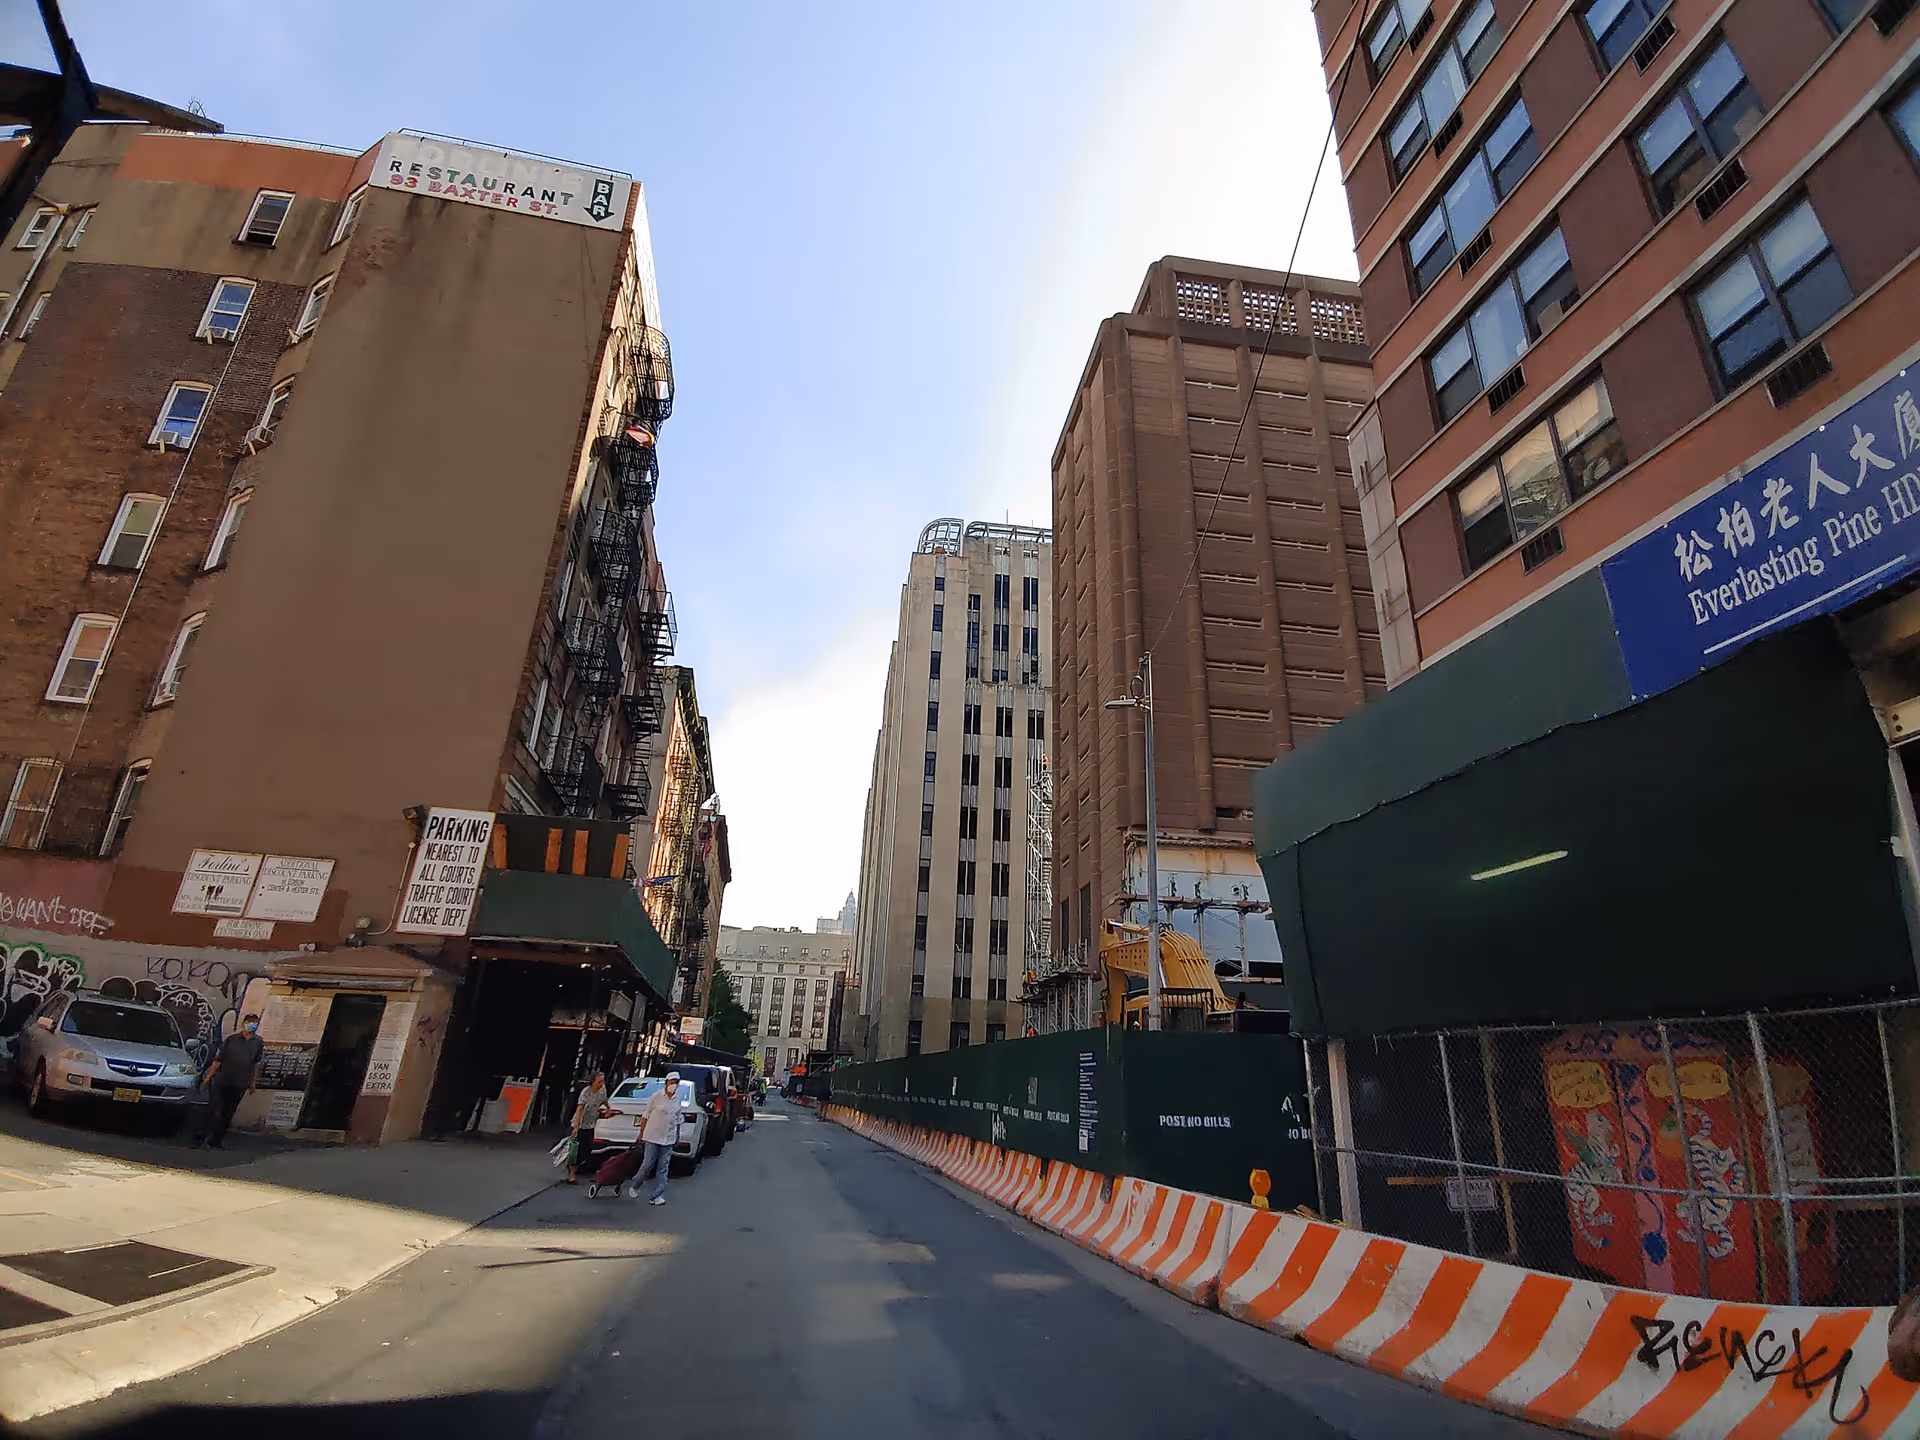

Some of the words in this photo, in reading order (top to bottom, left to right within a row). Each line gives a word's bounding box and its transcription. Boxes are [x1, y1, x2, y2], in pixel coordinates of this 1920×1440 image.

[389, 160, 574, 206] RESTAURANT
[389, 173, 418, 189] 93
[427, 180, 519, 209] BAXTER
[529, 200, 560, 216] ST.
[591, 183, 610, 217] BAR
[1687, 536, 1825, 626] Everlasting
[1823, 503, 1882, 557] Pine
[1880, 465, 1920, 525] HD
[426, 816, 490, 843] PARKING
[424, 842, 465, 861] NEAREST
[467, 846, 480, 864] TO
[186, 872, 221, 883] DISCOUNT
[222, 875, 252, 885] PARKING
[263, 868, 297, 878] DISCOUNT
[297, 871, 329, 881] PARKING
[418, 863, 435, 881] ALL
[408, 883, 444, 904] TRAFFIC
[445, 886, 475, 906] COURT
[402, 905, 441, 925] LICENSE
[441, 908, 467, 928] DEPT.
[373, 1062, 390, 1071] VAN
[365, 1081, 392, 1090] EXTRA
[1159, 1115, 1185, 1127] POST
[1186, 1116, 1202, 1127] NO
[1203, 1116, 1231, 1128] BILLS
